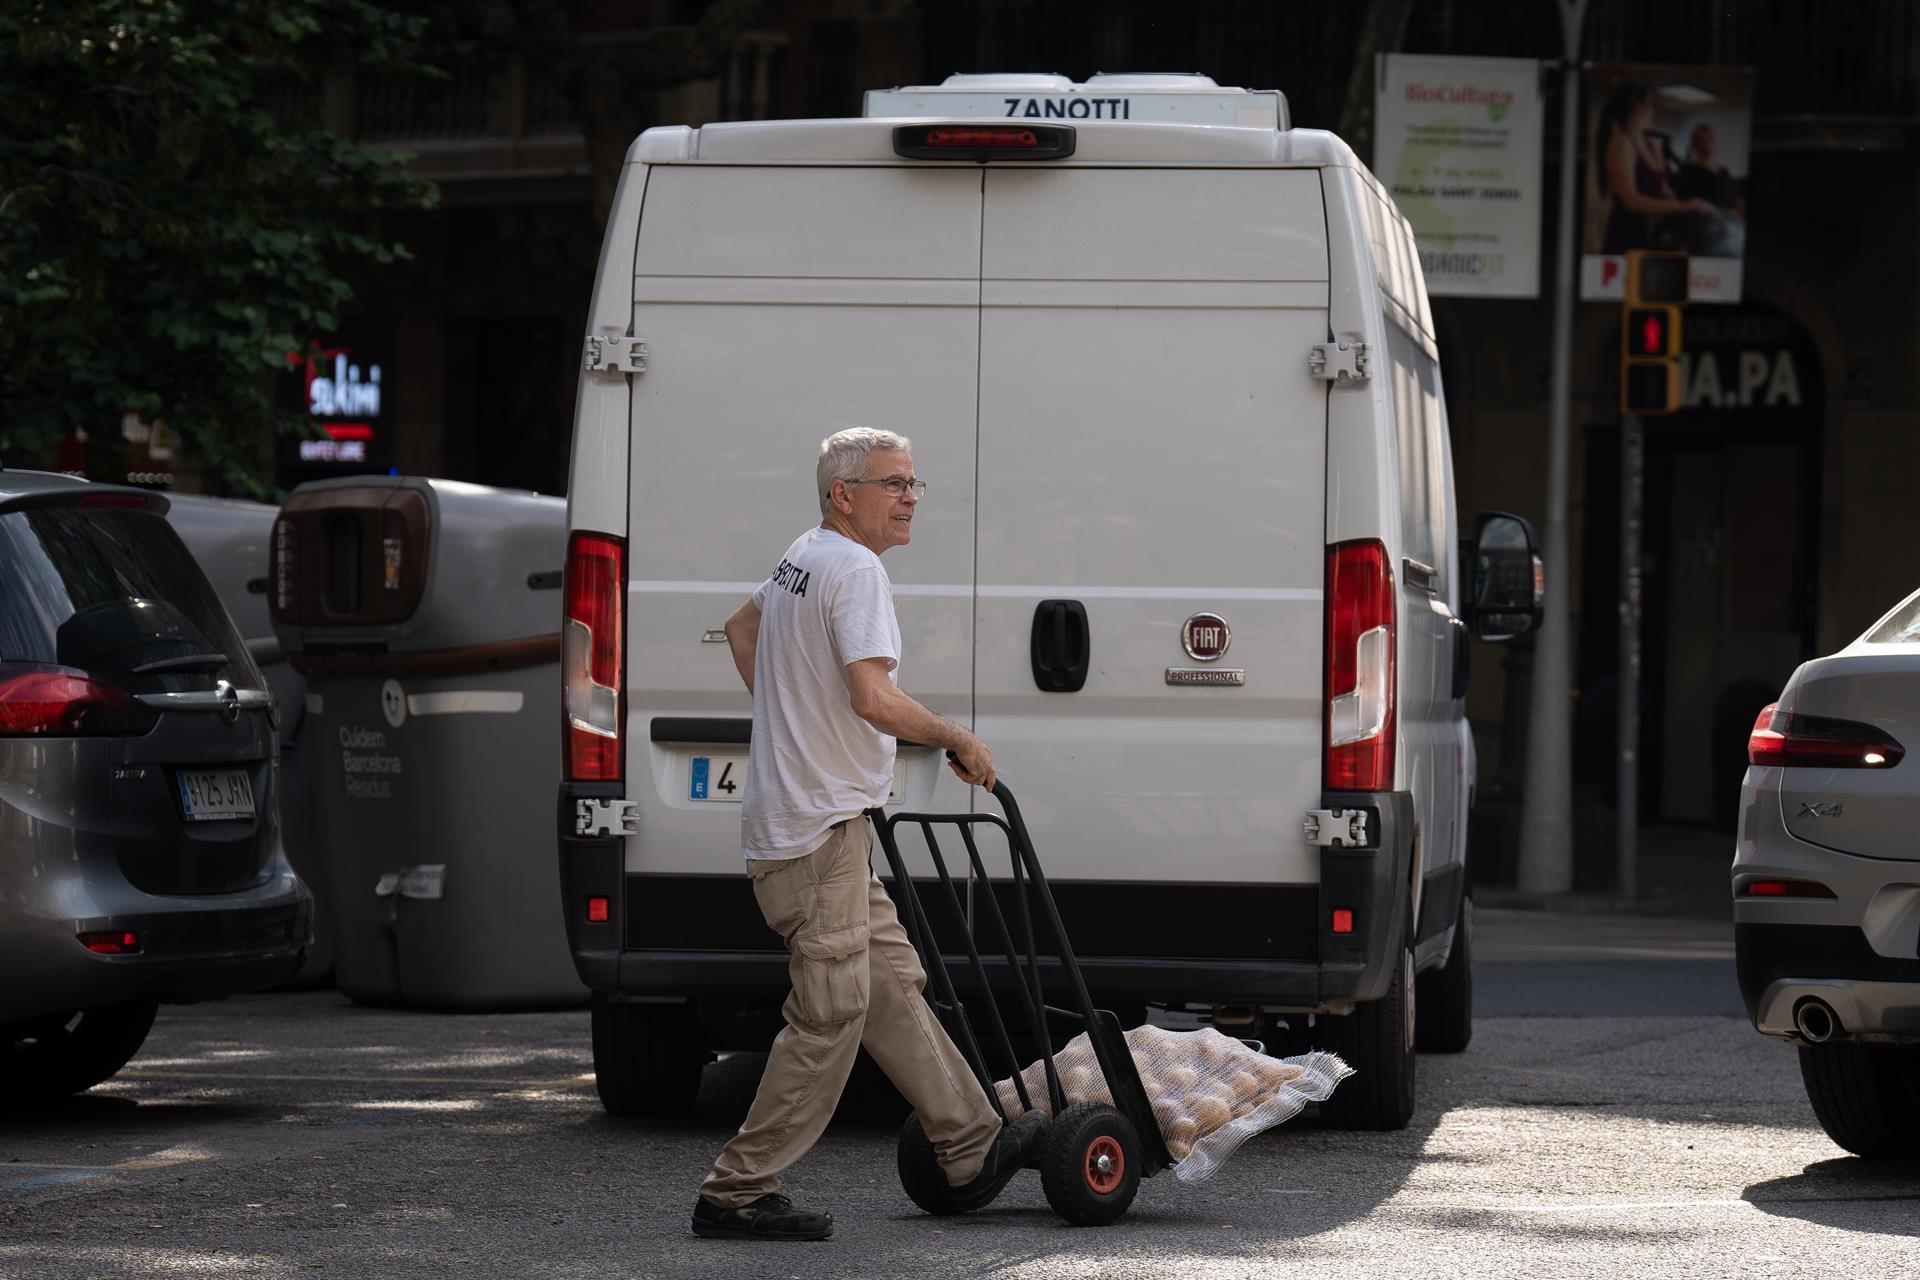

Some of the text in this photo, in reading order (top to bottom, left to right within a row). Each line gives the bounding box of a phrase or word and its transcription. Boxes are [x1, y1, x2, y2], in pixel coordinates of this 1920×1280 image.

[1004, 98, 1129, 120] ZANOTTI
[1193, 627, 1221, 649] FIAT
[1171, 672, 1239, 682] PROFESSIONAL
[342, 749, 402, 774] Barcelona
